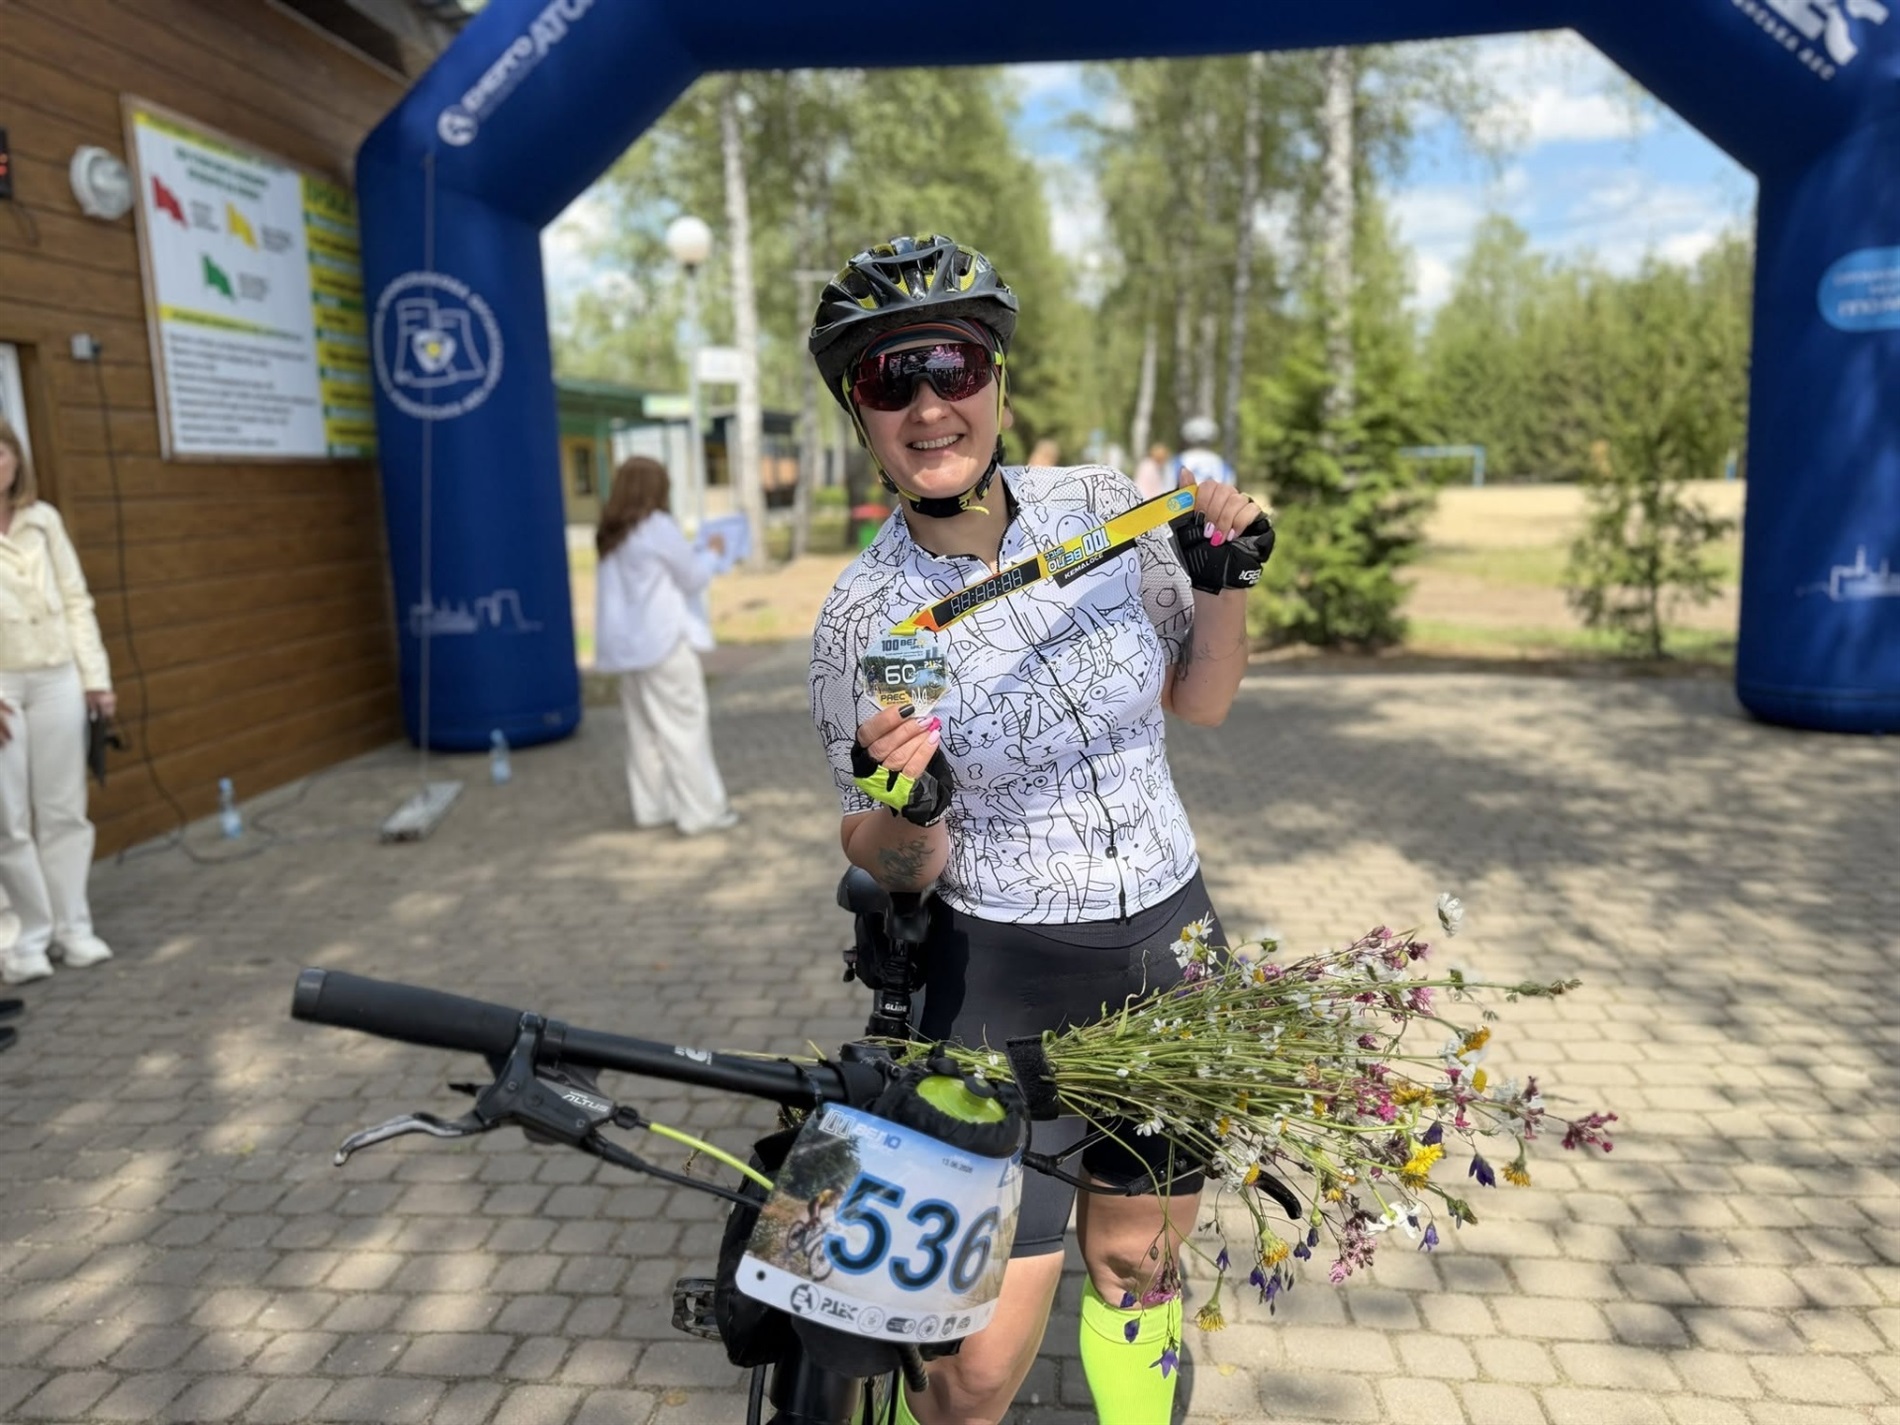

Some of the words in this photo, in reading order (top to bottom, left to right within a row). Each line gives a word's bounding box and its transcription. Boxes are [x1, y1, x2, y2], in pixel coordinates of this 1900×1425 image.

[1082, 526, 1111, 557] 100
[1047, 547, 1083, 573] ВЕЛО
[882, 639, 899, 652] 100
[885, 664, 916, 685] 60
[562, 1094, 609, 1112] ALTUS
[823, 1169, 1000, 1294] 536
